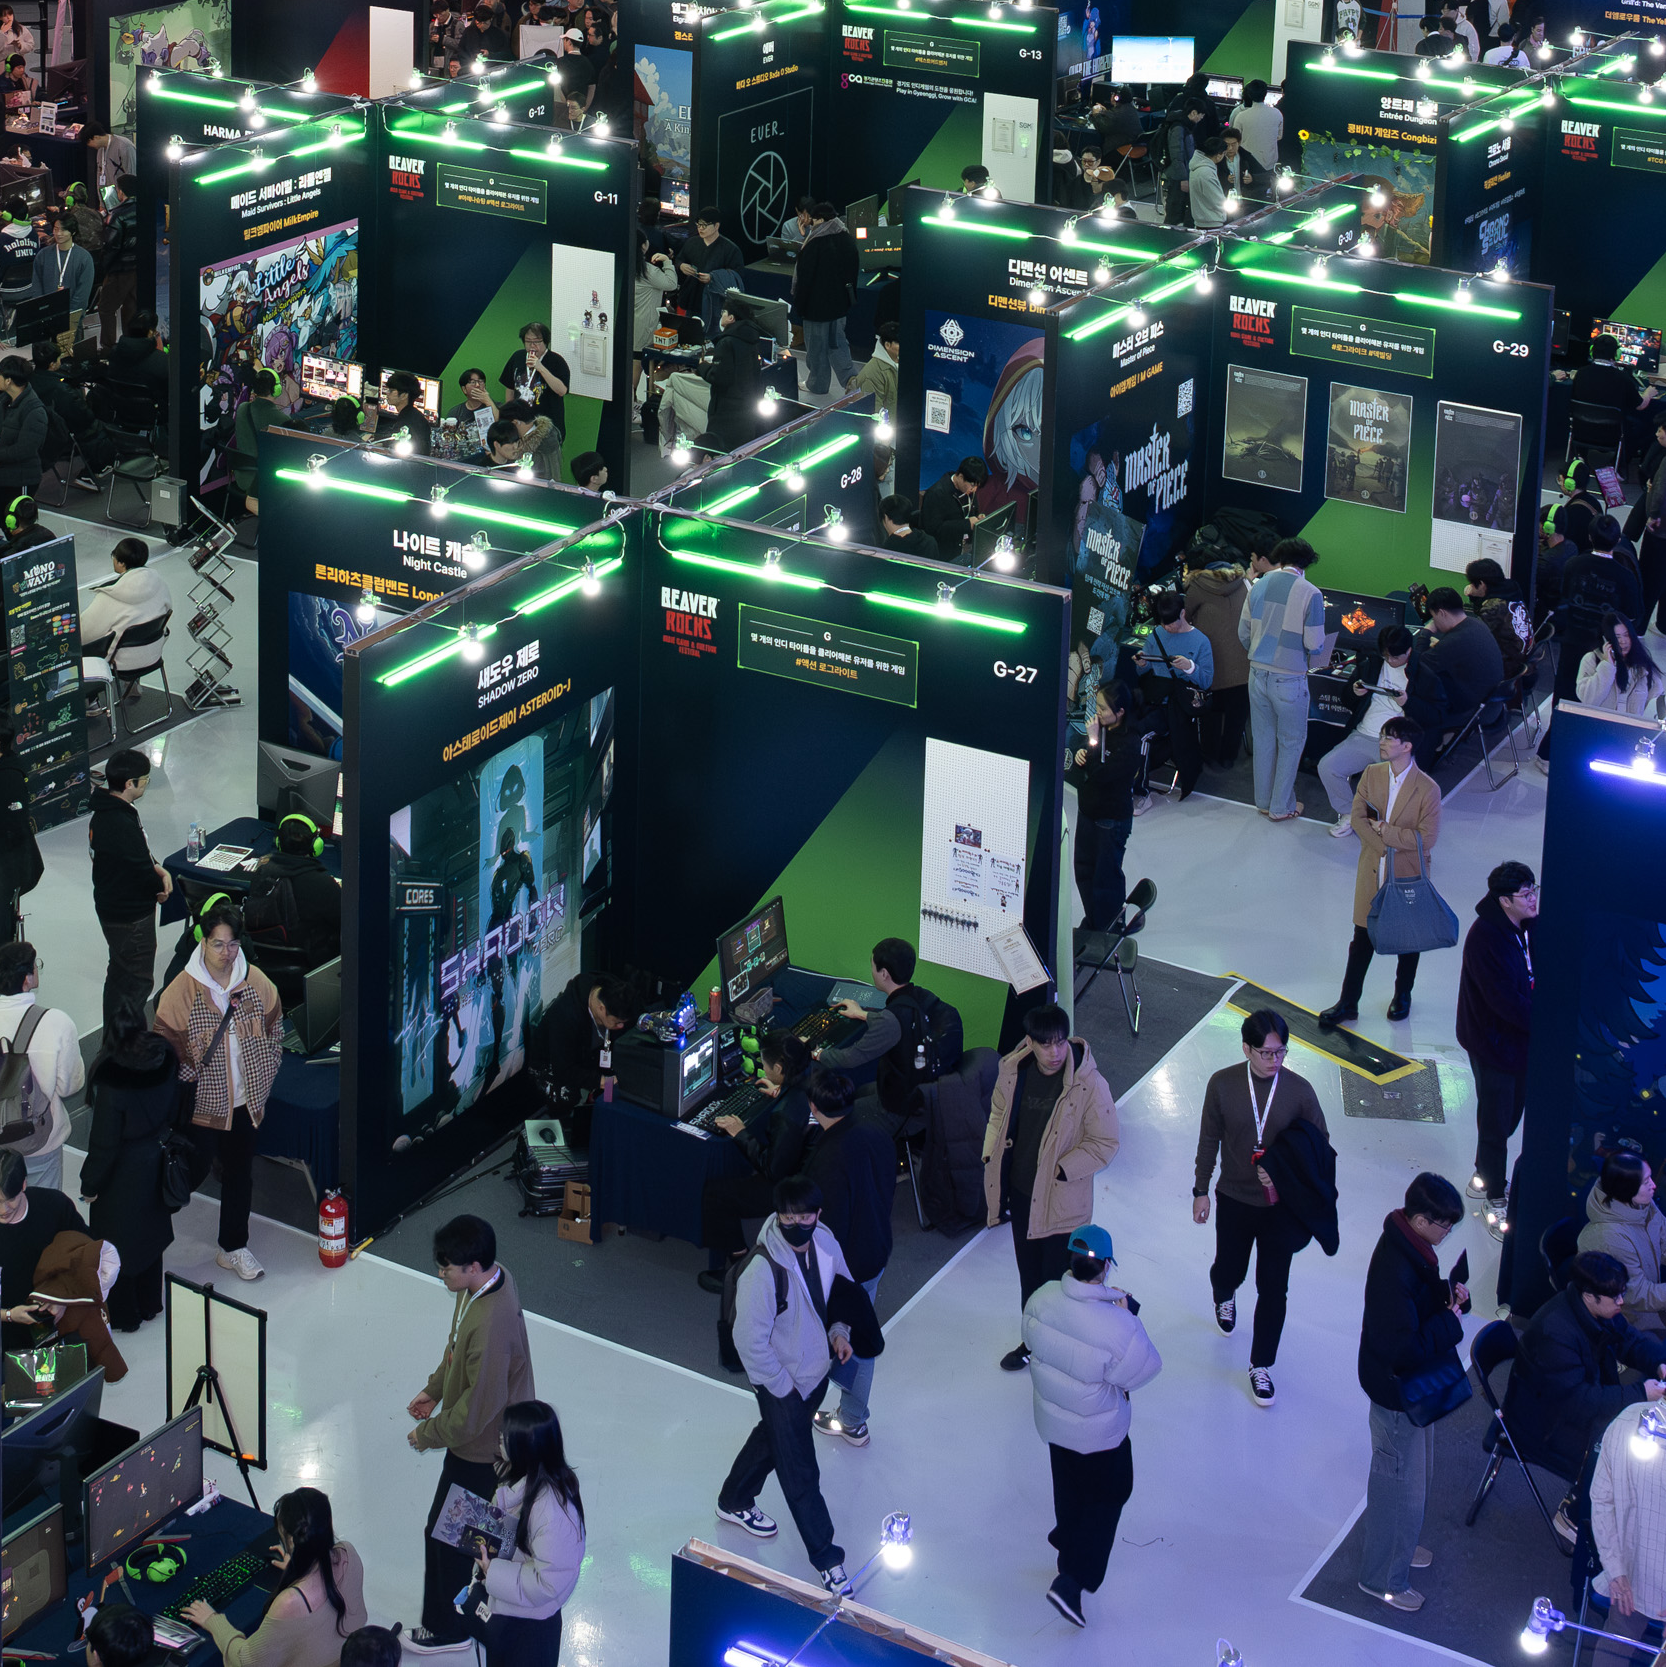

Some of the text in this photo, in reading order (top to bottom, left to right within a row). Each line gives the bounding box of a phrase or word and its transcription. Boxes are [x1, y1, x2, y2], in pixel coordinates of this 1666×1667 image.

[1642, 0, 1654, 8] The
[1019, 47, 1042, 60] G-13
[1380, 111, 1437, 125] Entrée Dungeon
[231, 179, 293, 209] 메이드 서바이벌
[594, 191, 618, 205] G-11
[283, 210, 319, 227] MilkEmpire
[254, 254, 295, 297] Little
[1008, 259, 1088, 285] 디멘션 어센트
[263, 260, 310, 308] Angels
[928, 344, 975, 358] DIMENSION
[933, 351, 968, 363] ASCENT
[1493, 340, 1529, 357] G-29
[1350, 398, 1389, 423] MASTER
[1354, 423, 1383, 444] PIECE
[840, 466, 862, 489] G-28
[393, 530, 441, 557] 나이트
[403, 555, 467, 578] Night Castle
[993, 661, 1037, 684] G-27
[478, 666, 538, 709] SHADOW ZERO
[443, 679, 571, 761] 아스테로이드제이 ASTEROID-J
